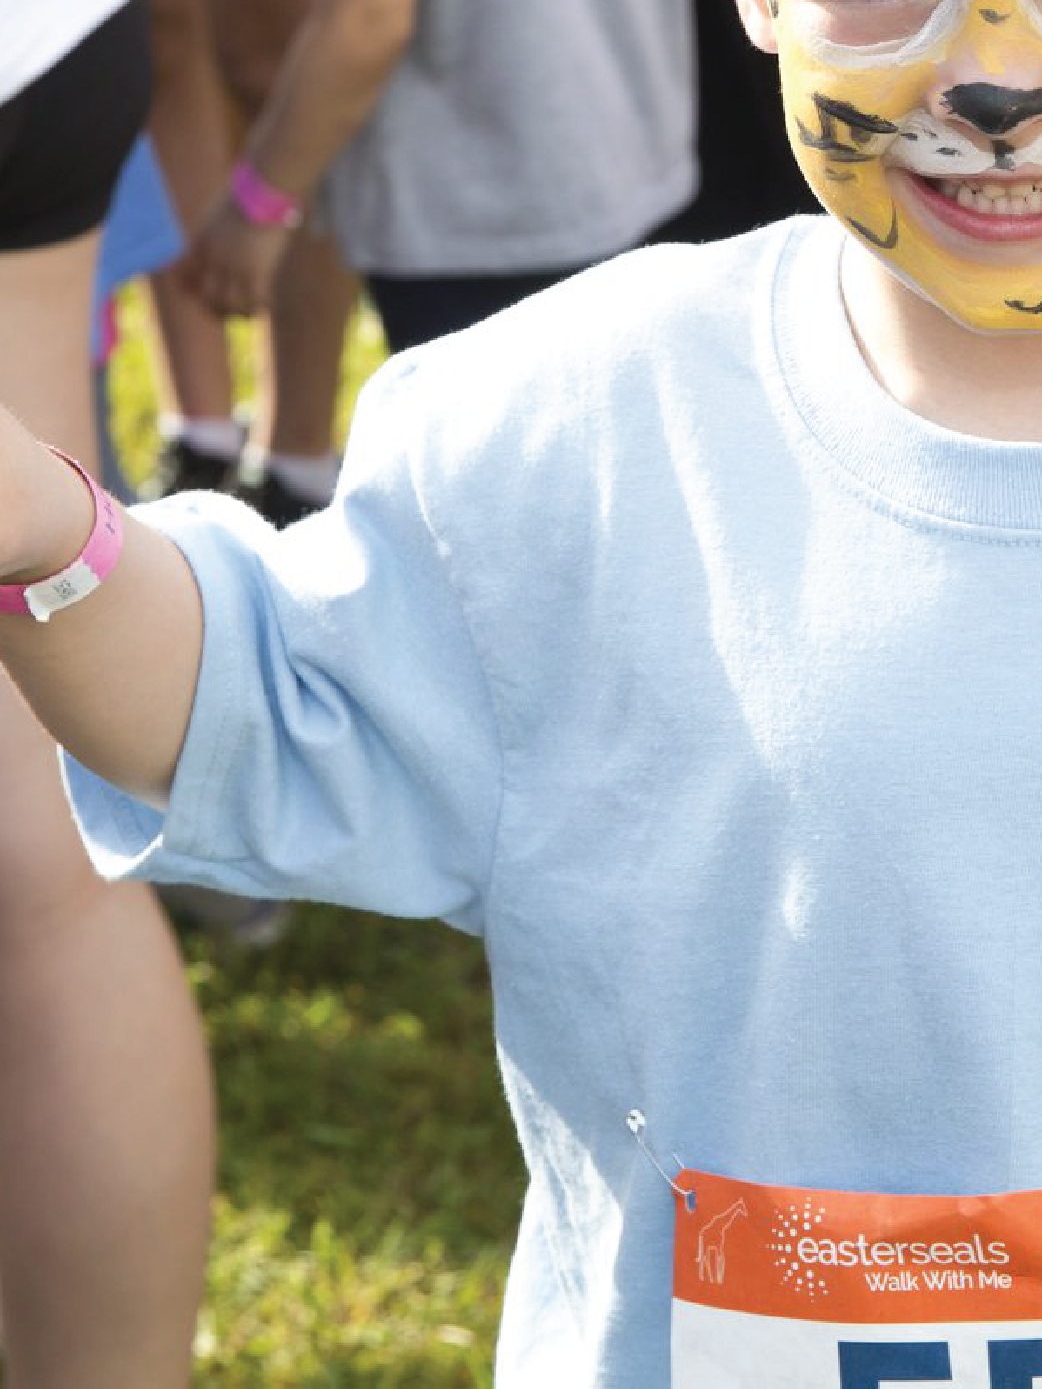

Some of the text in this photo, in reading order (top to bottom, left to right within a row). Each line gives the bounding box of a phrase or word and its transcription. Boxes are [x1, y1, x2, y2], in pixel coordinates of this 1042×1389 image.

[797, 1233, 1010, 1267] easterseals
[865, 1270, 1012, 1292] Walk With Me
